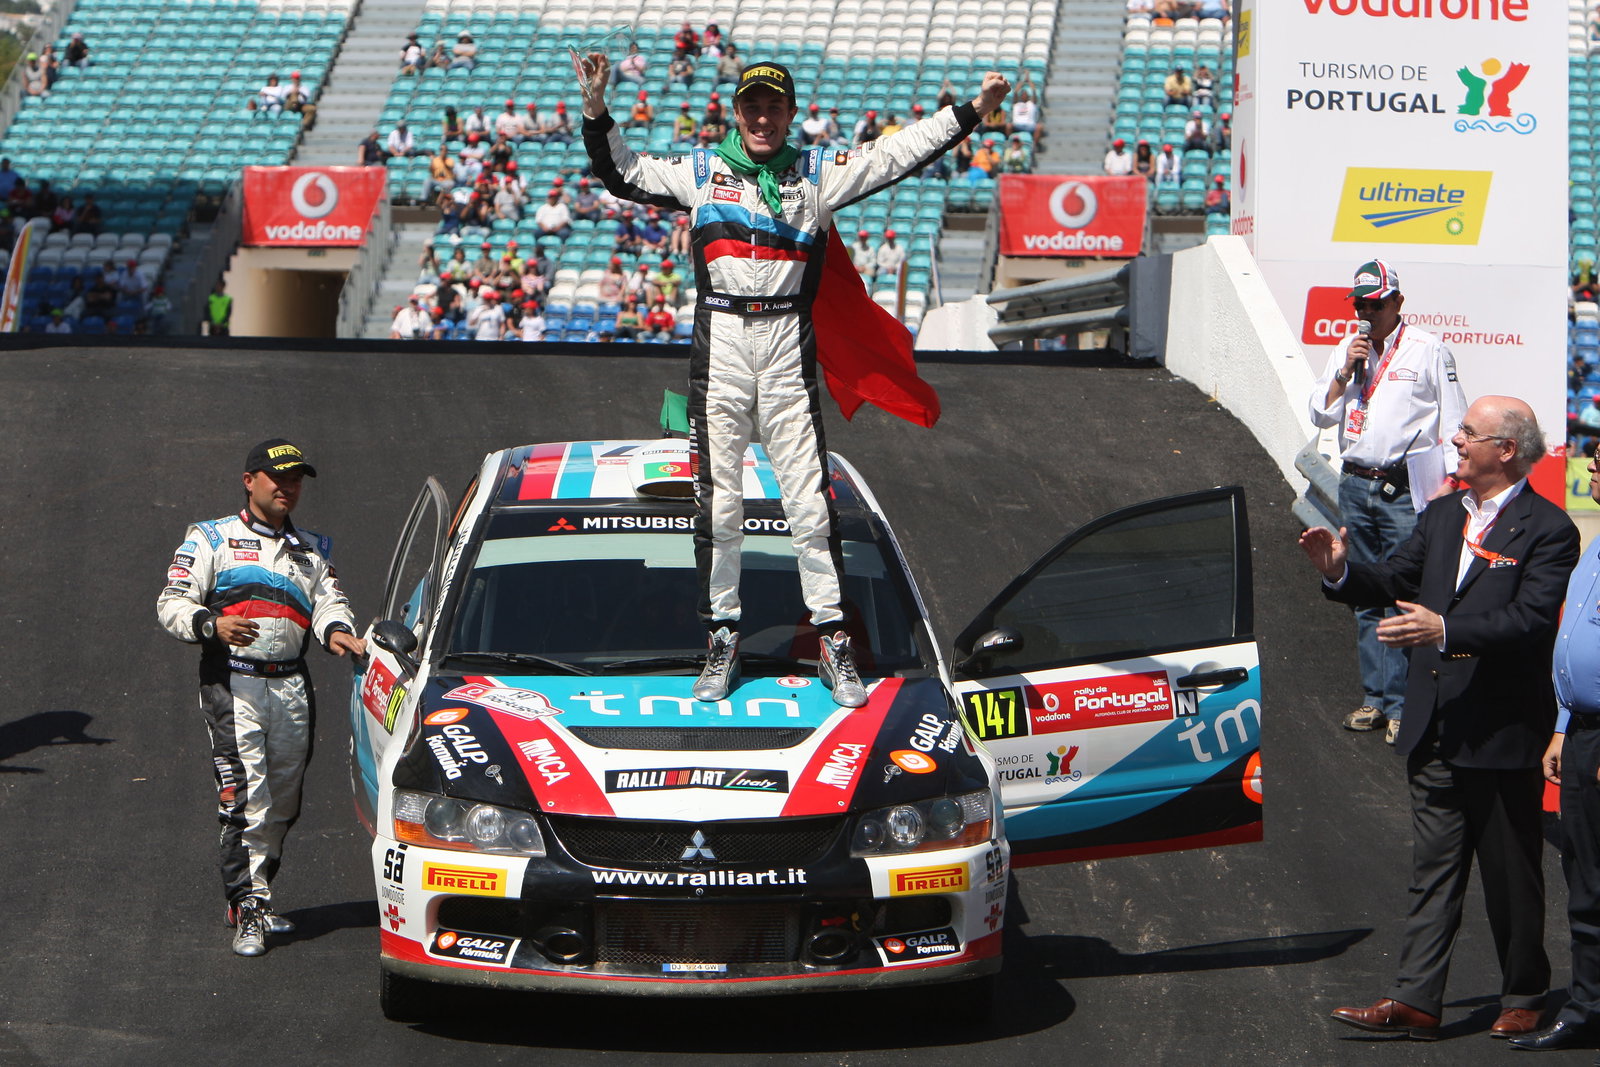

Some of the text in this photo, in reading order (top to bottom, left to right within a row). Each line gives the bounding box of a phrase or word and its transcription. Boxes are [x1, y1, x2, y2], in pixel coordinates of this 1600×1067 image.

[742, 66, 785, 83] PIRELLI
[1299, 61, 1428, 81] TURISMO DE
[1287, 89, 1446, 114] PORTUGAL
[1359, 182, 1465, 204] ultimate
[264, 221, 362, 240] vodafone
[1023, 230, 1124, 251] vodafone
[705, 296, 730, 305] sparco
[1442, 332, 1525, 346] PORTUGAL
[583, 517, 696, 531] MITSUBIS
[1074, 688, 1095, 696] rally
[1074, 688, 1168, 711] Portugal
[1176, 691, 1197, 715] N
[970, 690, 1017, 738] 147
[1035, 712, 1071, 722] vodafone
[909, 713, 941, 752] GALP
[442, 723, 489, 764] GALP
[1021, 754, 1034, 763] DE
[616, 770, 778, 789] RALLI ART Italy
[428, 867, 498, 891] PIRELLI
[592, 867, 807, 887] www.ralliart.it
[896, 867, 963, 891] PIRELLI
[456, 937, 506, 950] GALP
[905, 933, 947, 947] GALP
